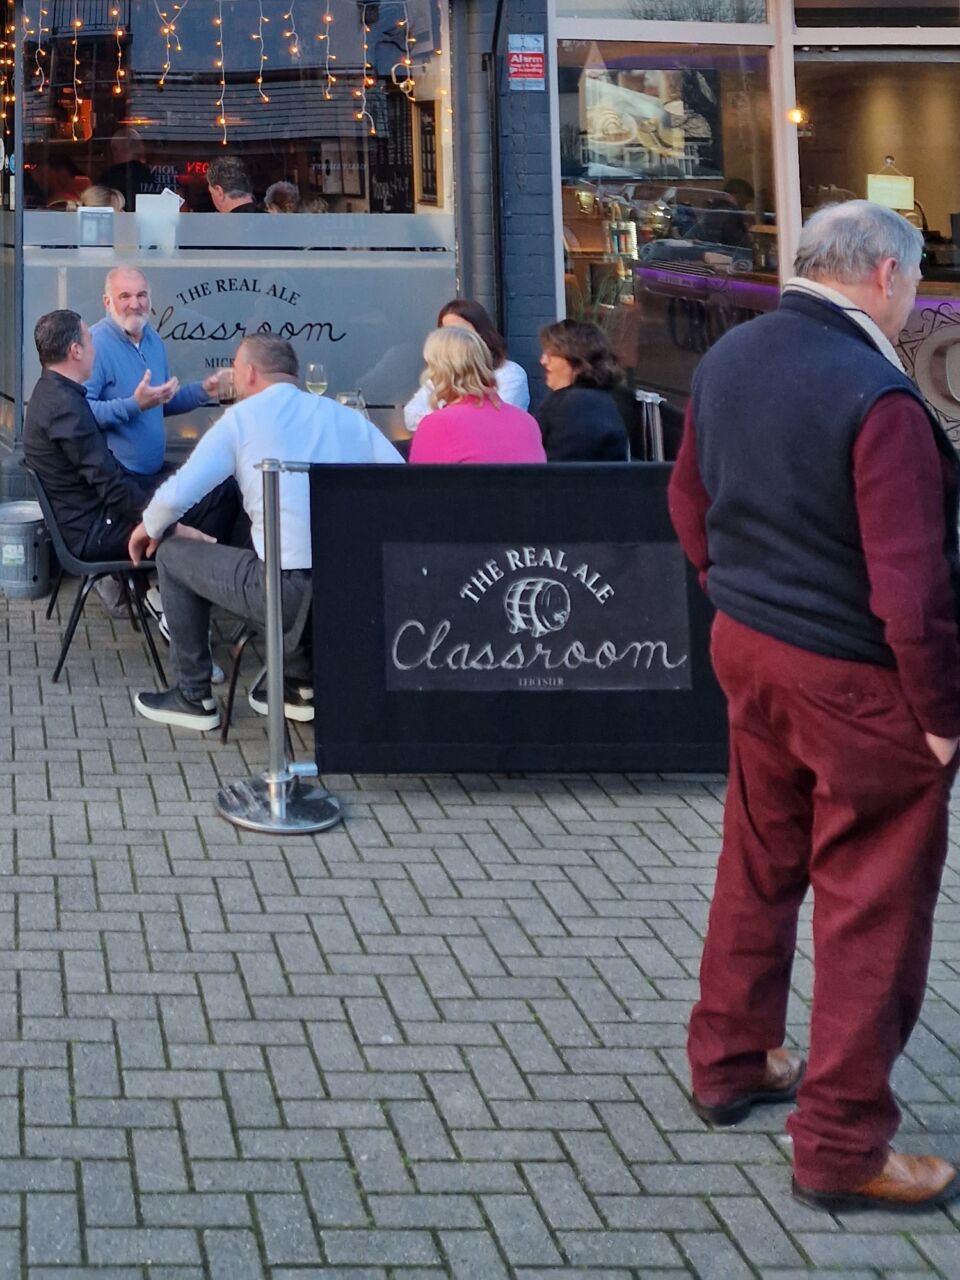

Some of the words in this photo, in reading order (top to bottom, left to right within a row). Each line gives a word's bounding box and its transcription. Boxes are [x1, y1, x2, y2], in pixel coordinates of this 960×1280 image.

[176, 282, 212, 305] THE
[215, 278, 261, 293] REAL
[266, 283, 301, 306] ALE
[151, 306, 346, 342] lassroom
[459, 559, 505, 604] THE
[506, 547, 568, 572] REAL
[572, 562, 615, 604] ALE
[391, 619, 688, 671] Classroom
